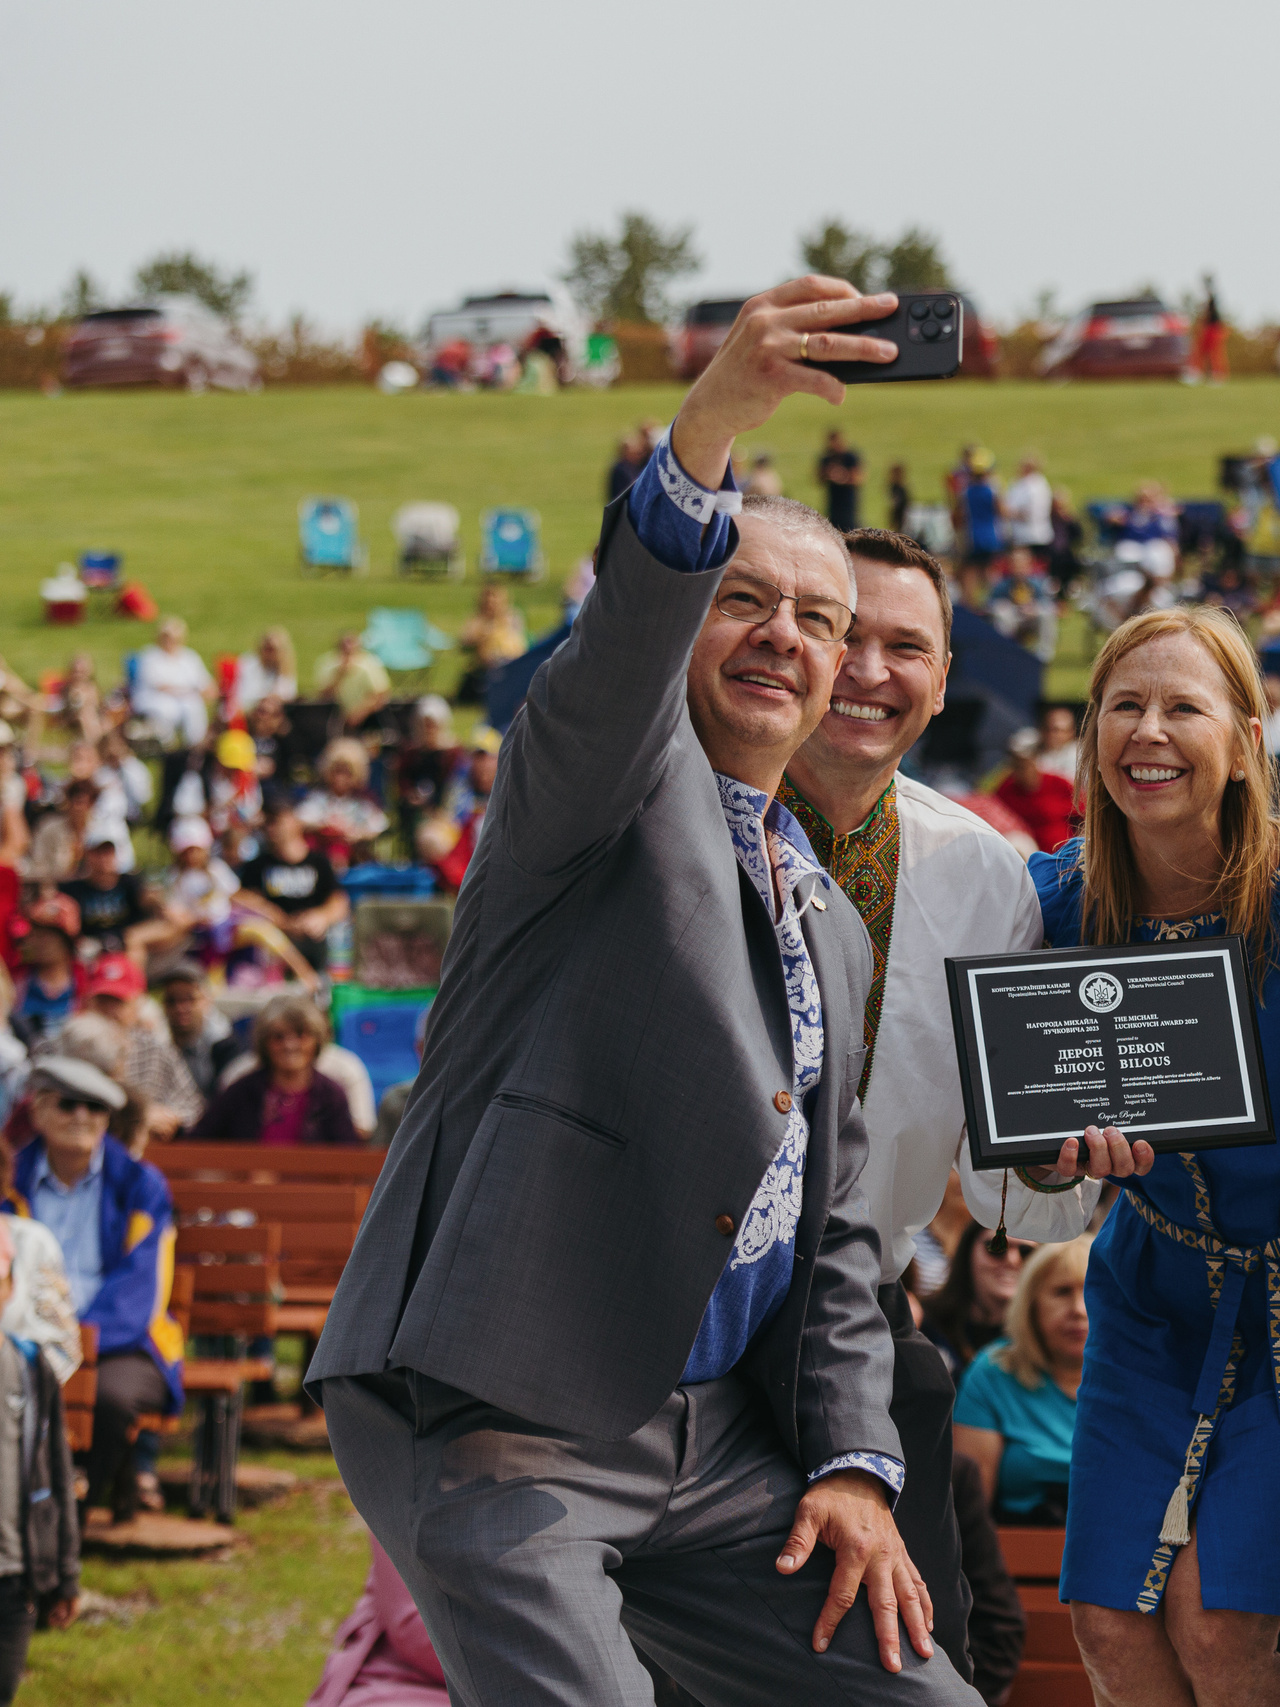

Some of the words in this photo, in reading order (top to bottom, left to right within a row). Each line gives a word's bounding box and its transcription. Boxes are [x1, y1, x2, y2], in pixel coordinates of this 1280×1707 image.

[1064, 1018, 1098, 1026] МИХАЙЛА
[1115, 1021, 1159, 1029] LUCHKOVICH
[1043, 1027, 1084, 1035] ЛУЧКОВИЧА
[1058, 1047, 1103, 1061] ДЕРОН
[1118, 1042, 1165, 1055] DERON
[1054, 1061, 1105, 1074] БІЛОУС
[1119, 1056, 1171, 1069] BILOUS
